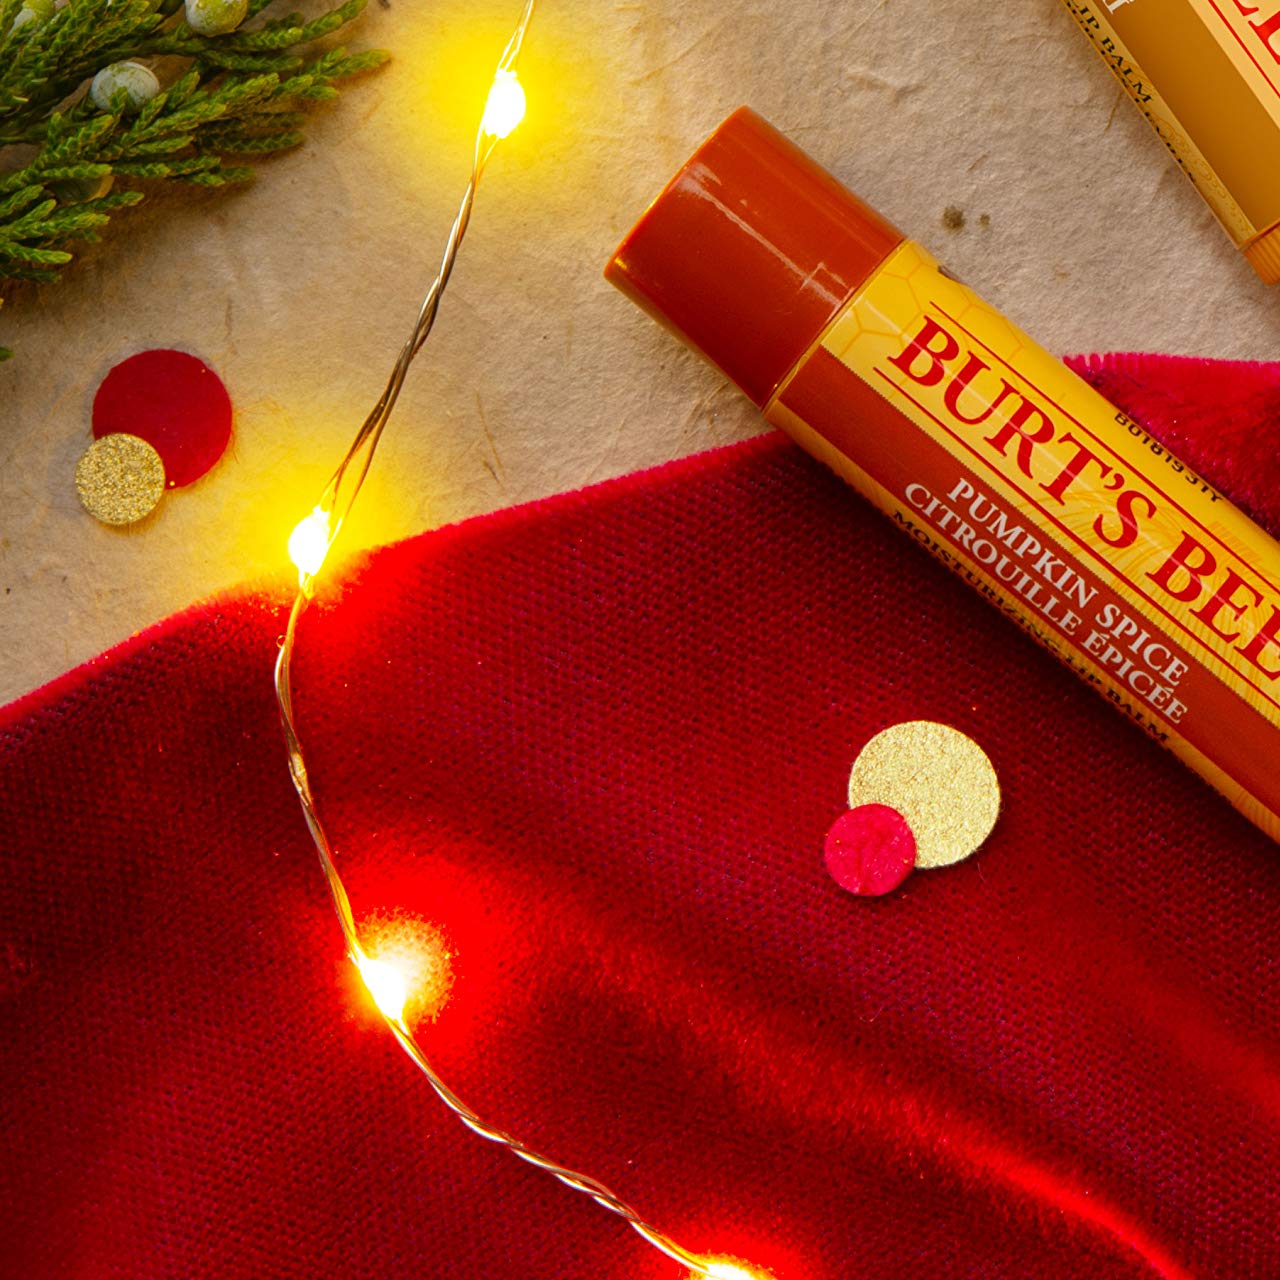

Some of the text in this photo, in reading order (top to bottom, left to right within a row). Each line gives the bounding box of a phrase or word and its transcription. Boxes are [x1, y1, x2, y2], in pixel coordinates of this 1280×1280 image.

[1101, 36, 1152, 104] BALM
[886, 315, 1158, 549] BURT'S
[905, 483, 1188, 724] CITROUILLE ÉPICÉE
[947, 477, 1189, 686] PUMPKIN SPICE
[1106, 688, 1169, 742] BALM
